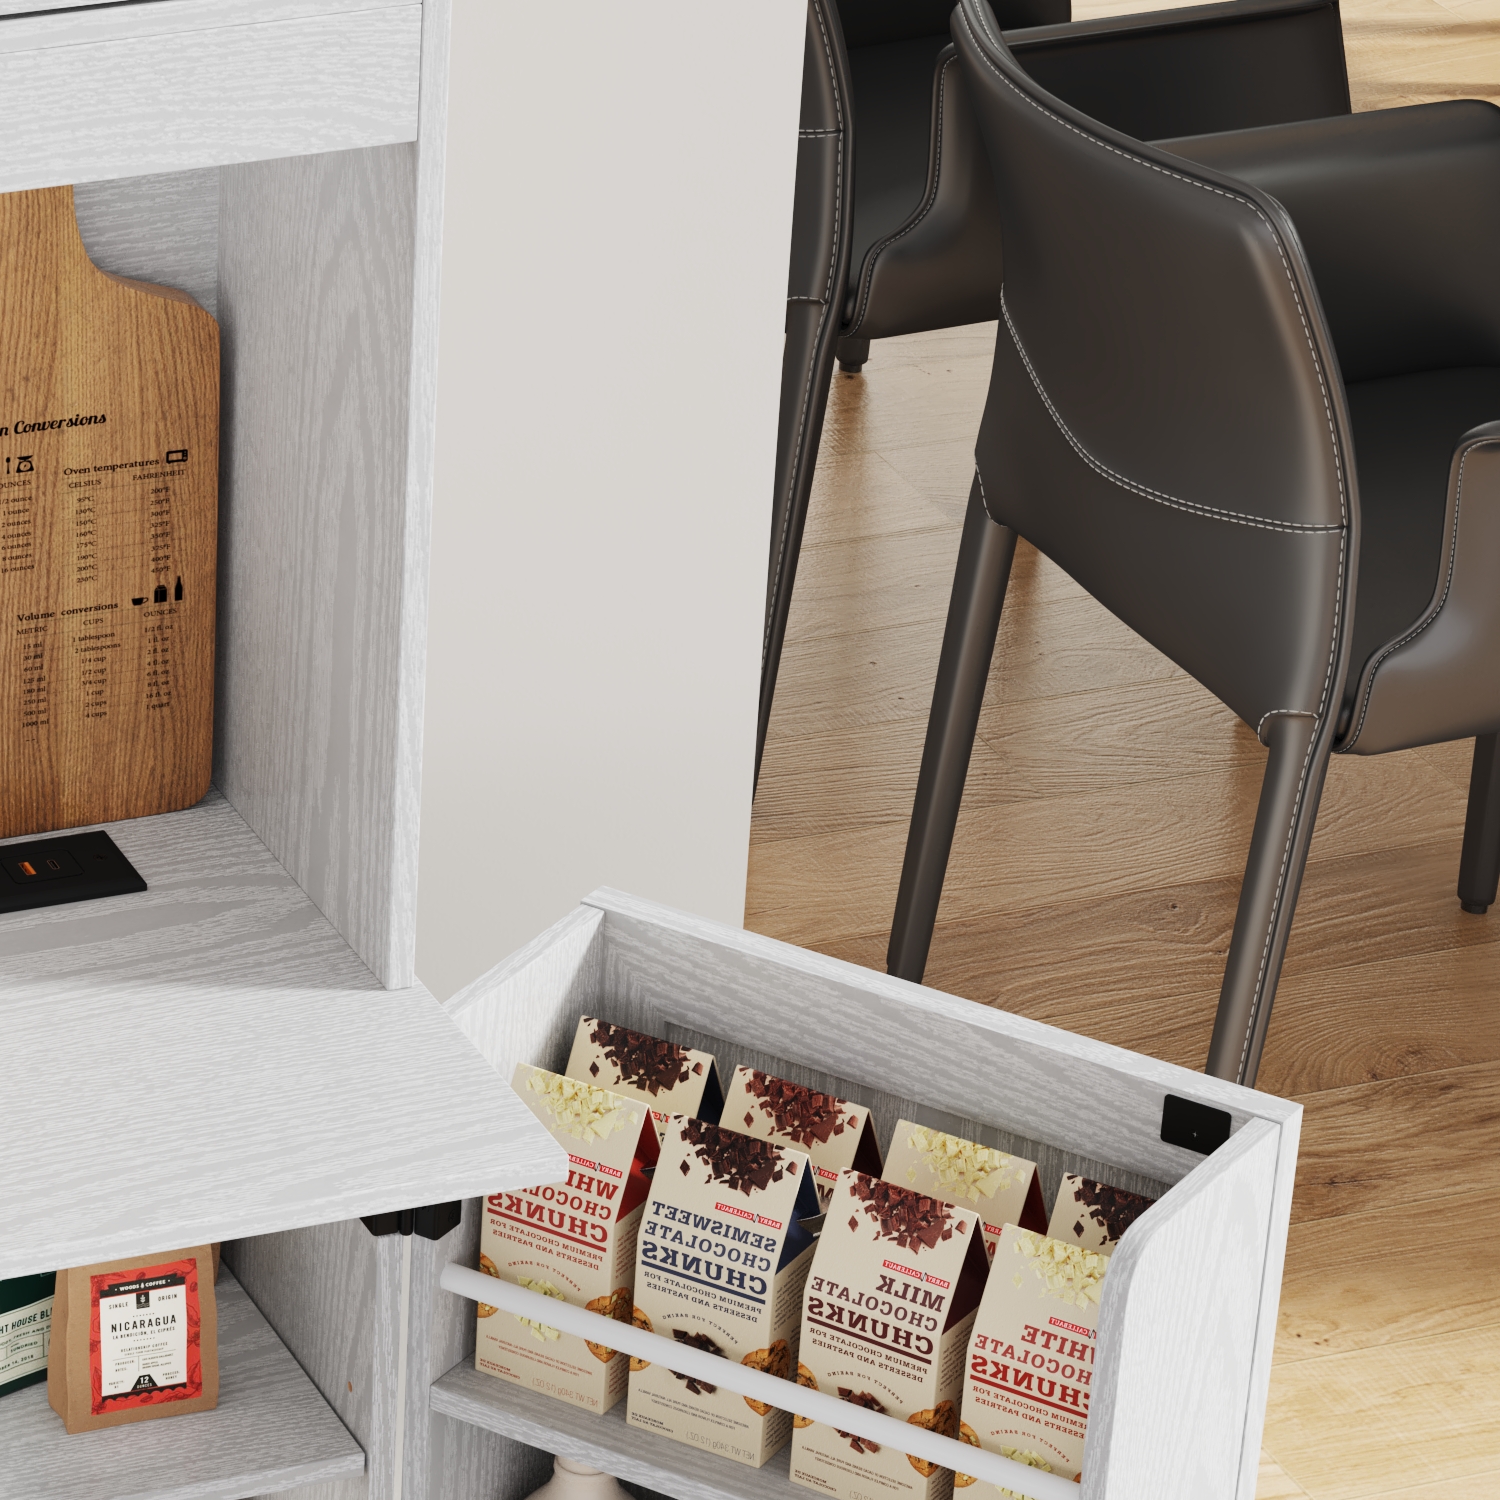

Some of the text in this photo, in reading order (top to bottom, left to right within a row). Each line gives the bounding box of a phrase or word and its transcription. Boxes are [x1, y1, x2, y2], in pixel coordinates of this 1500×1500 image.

[14, 414, 106, 434] Conversions
[64, 459, 159, 475] Oven temperatures
[69, 469, 185, 489] CELSIUS FAHRENHEIT
[10, 564, 35, 572] ounces
[17, 603, 118, 621] Volume conversions
[16, 608, 177, 635] METRIC CUPS OUNCES
[78, 632, 115, 642] tablespoon
[81, 642, 121, 652] tablespoons
[158, 1294, 177, 1302] ORIGIN
[12, 1313, 37, 1330] HOUSE
[111, 1314, 177, 1332] NICARAGUA
[140, 1376, 149, 1384] 12
